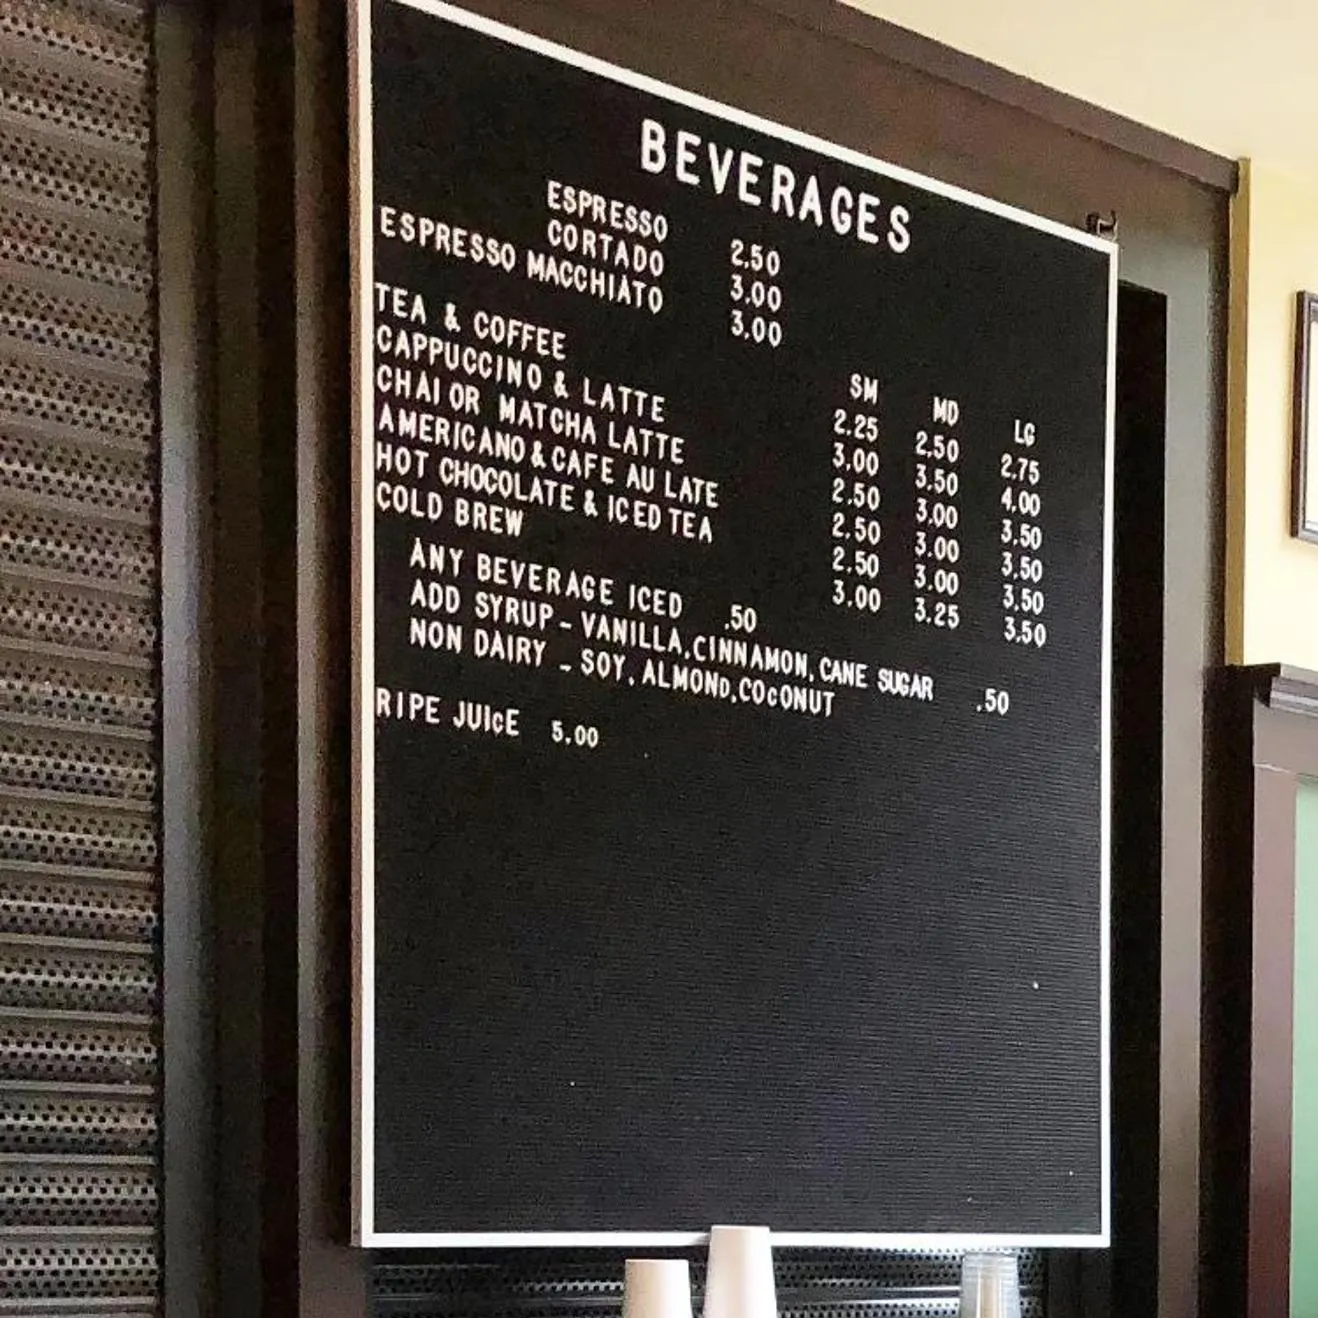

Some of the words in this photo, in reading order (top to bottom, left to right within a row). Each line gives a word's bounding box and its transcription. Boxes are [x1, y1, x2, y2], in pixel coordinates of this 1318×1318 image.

[547, 180, 668, 243] ESPRESSO
[730, 239, 781, 277] 2.50
[641, 118, 911, 254] BEVERAGES
[380, 206, 516, 273] ESPRESSO
[527, 249, 663, 315] MACCHIATO
[731, 309, 782, 348] 3.00
[547, 219, 664, 277] CORTADO
[730, 273, 782, 312] 3.00
[374, 282, 427, 325] TEA
[444, 302, 461, 333] &
[473, 311, 566, 361] COFFEE
[833, 408, 879, 443] 2.25
[915, 430, 960, 463] 2.50
[1000, 453, 1040, 486] 2.75
[376, 324, 542, 391] CAPPUCCINO
[553, 370, 569, 399] &
[583, 377, 665, 423] LATTE
[832, 442, 879, 477] 3.00
[915, 463, 959, 497] 3.50
[1001, 486, 1041, 517] 4.00
[849, 373, 878, 405] SM
[933, 396, 960, 427] MD
[1014, 419, 1036, 447] LG
[376, 364, 440, 405] CHAI
[449, 382, 480, 415] OR
[499, 393, 597, 445] MATCHA
[608, 421, 685, 465] LATTE
[832, 477, 881, 512] 2.50
[915, 497, 958, 530] 3.00
[1000, 518, 1043, 551] 3.50
[626, 463, 655, 494] AU
[664, 470, 719, 508] LATE
[832, 512, 881, 546] 2.50
[914, 531, 960, 564] 3.00
[1001, 551, 1043, 584] 3.50
[376, 441, 430, 478] HOT
[439, 456, 575, 512] CHOCOLATE
[583, 489, 599, 517] &
[607, 494, 662, 531] ICED
[668, 507, 713, 543] TEA
[832, 545, 880, 579] 2.50
[914, 563, 959, 597] 3.00
[1002, 583, 1045, 616] 3.50
[376, 481, 443, 520] COLD
[454, 497, 524, 537] BREW
[832, 579, 881, 613] 3.00
[914, 596, 960, 630] 3.25
[1003, 616, 1047, 649] 3.50
[409, 537, 464, 577] ANY
[477, 552, 614, 606] BEVERAGE
[629, 584, 683, 619] ICED
[724, 604, 757, 633] .50
[410, 617, 463, 654] NON
[474, 628, 547, 667] DAIRY
[410, 578, 461, 614] ADD
[819, 656, 869, 689] CANE
[877, 667, 934, 702] SUGAR
[976, 688, 1010, 716] .50
[376, 687, 441, 724] RIPE
[551, 720, 599, 748] 5.00
